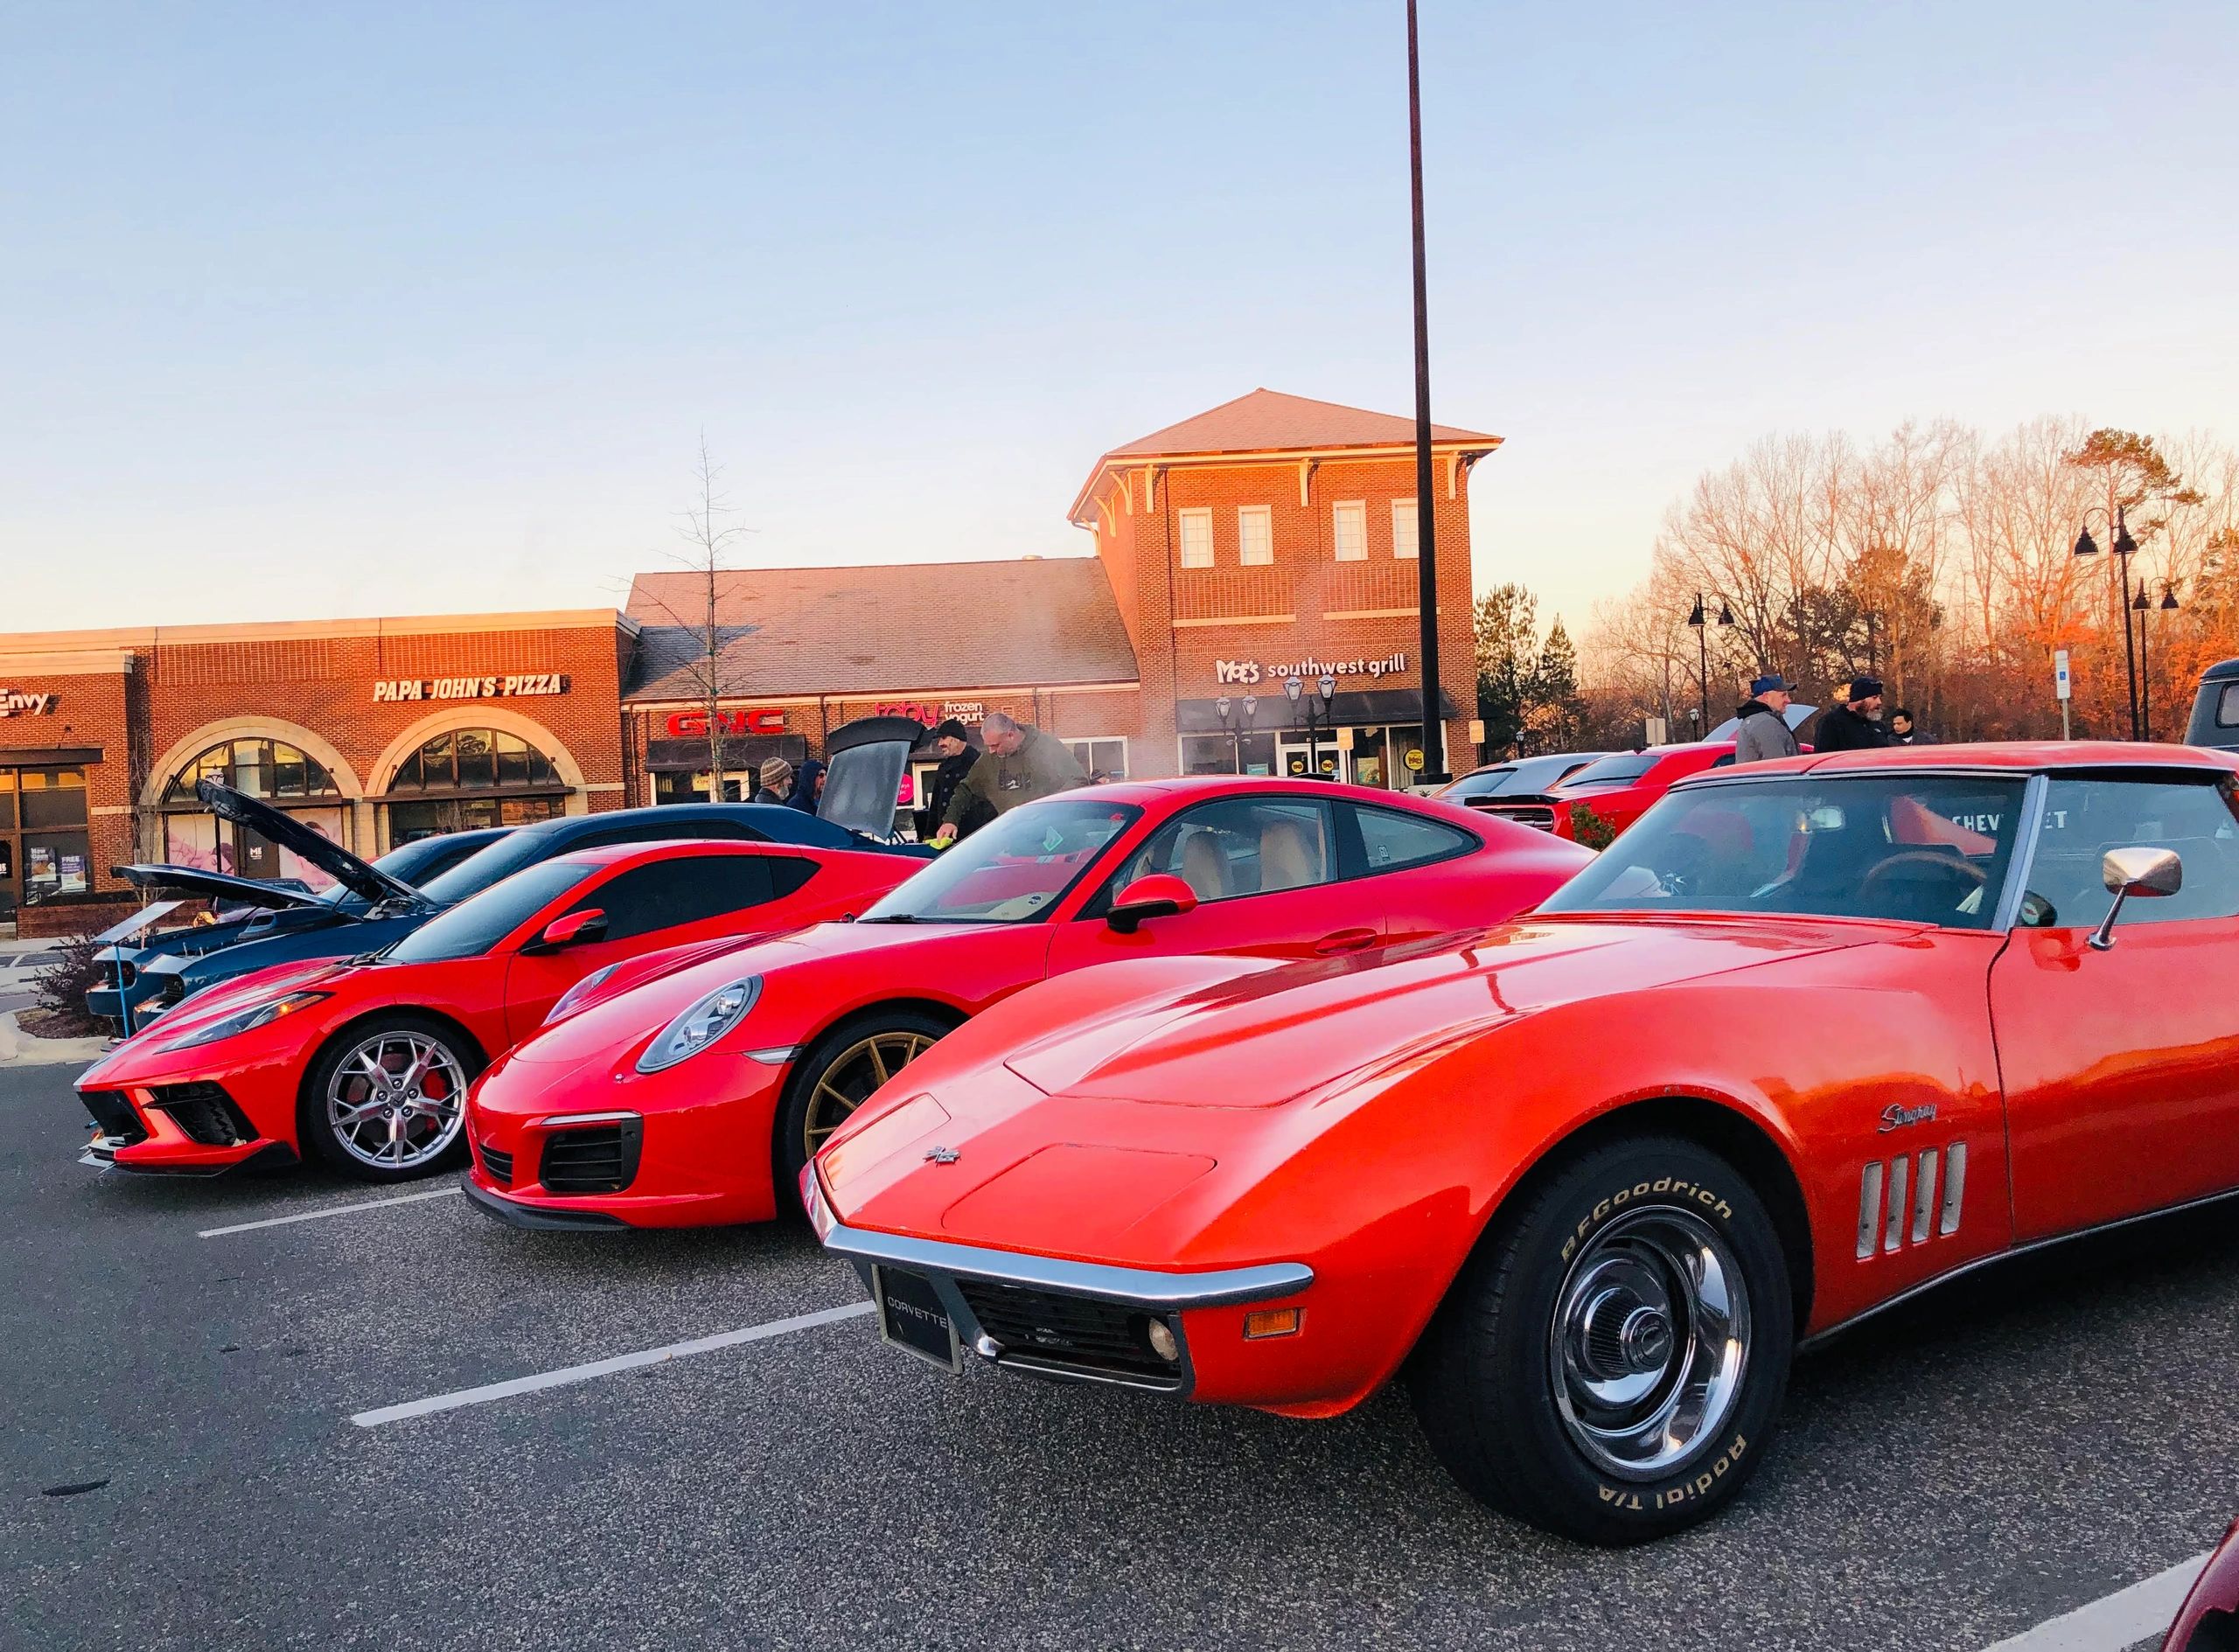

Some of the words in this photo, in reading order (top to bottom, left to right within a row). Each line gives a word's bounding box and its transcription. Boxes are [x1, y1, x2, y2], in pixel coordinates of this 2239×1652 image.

[1267, 657, 1365, 678] southwest
[1368, 652, 1405, 678] grill
[373, 680, 422, 702] PAPA
[430, 676, 497, 700] JOHN'S
[503, 673, 561, 697] PIZZA
[0, 688, 50, 716] Envy
[944, 701, 983, 714] frozen
[666, 709, 785, 736] GNC
[944, 712, 985, 725] yogurt
[1561, 1176, 1733, 1265] BFGoodrich
[887, 1296, 948, 1329] CORVETTE
[1656, 1434, 1747, 1509] Radial
[1599, 1483, 1643, 1510] T/A
